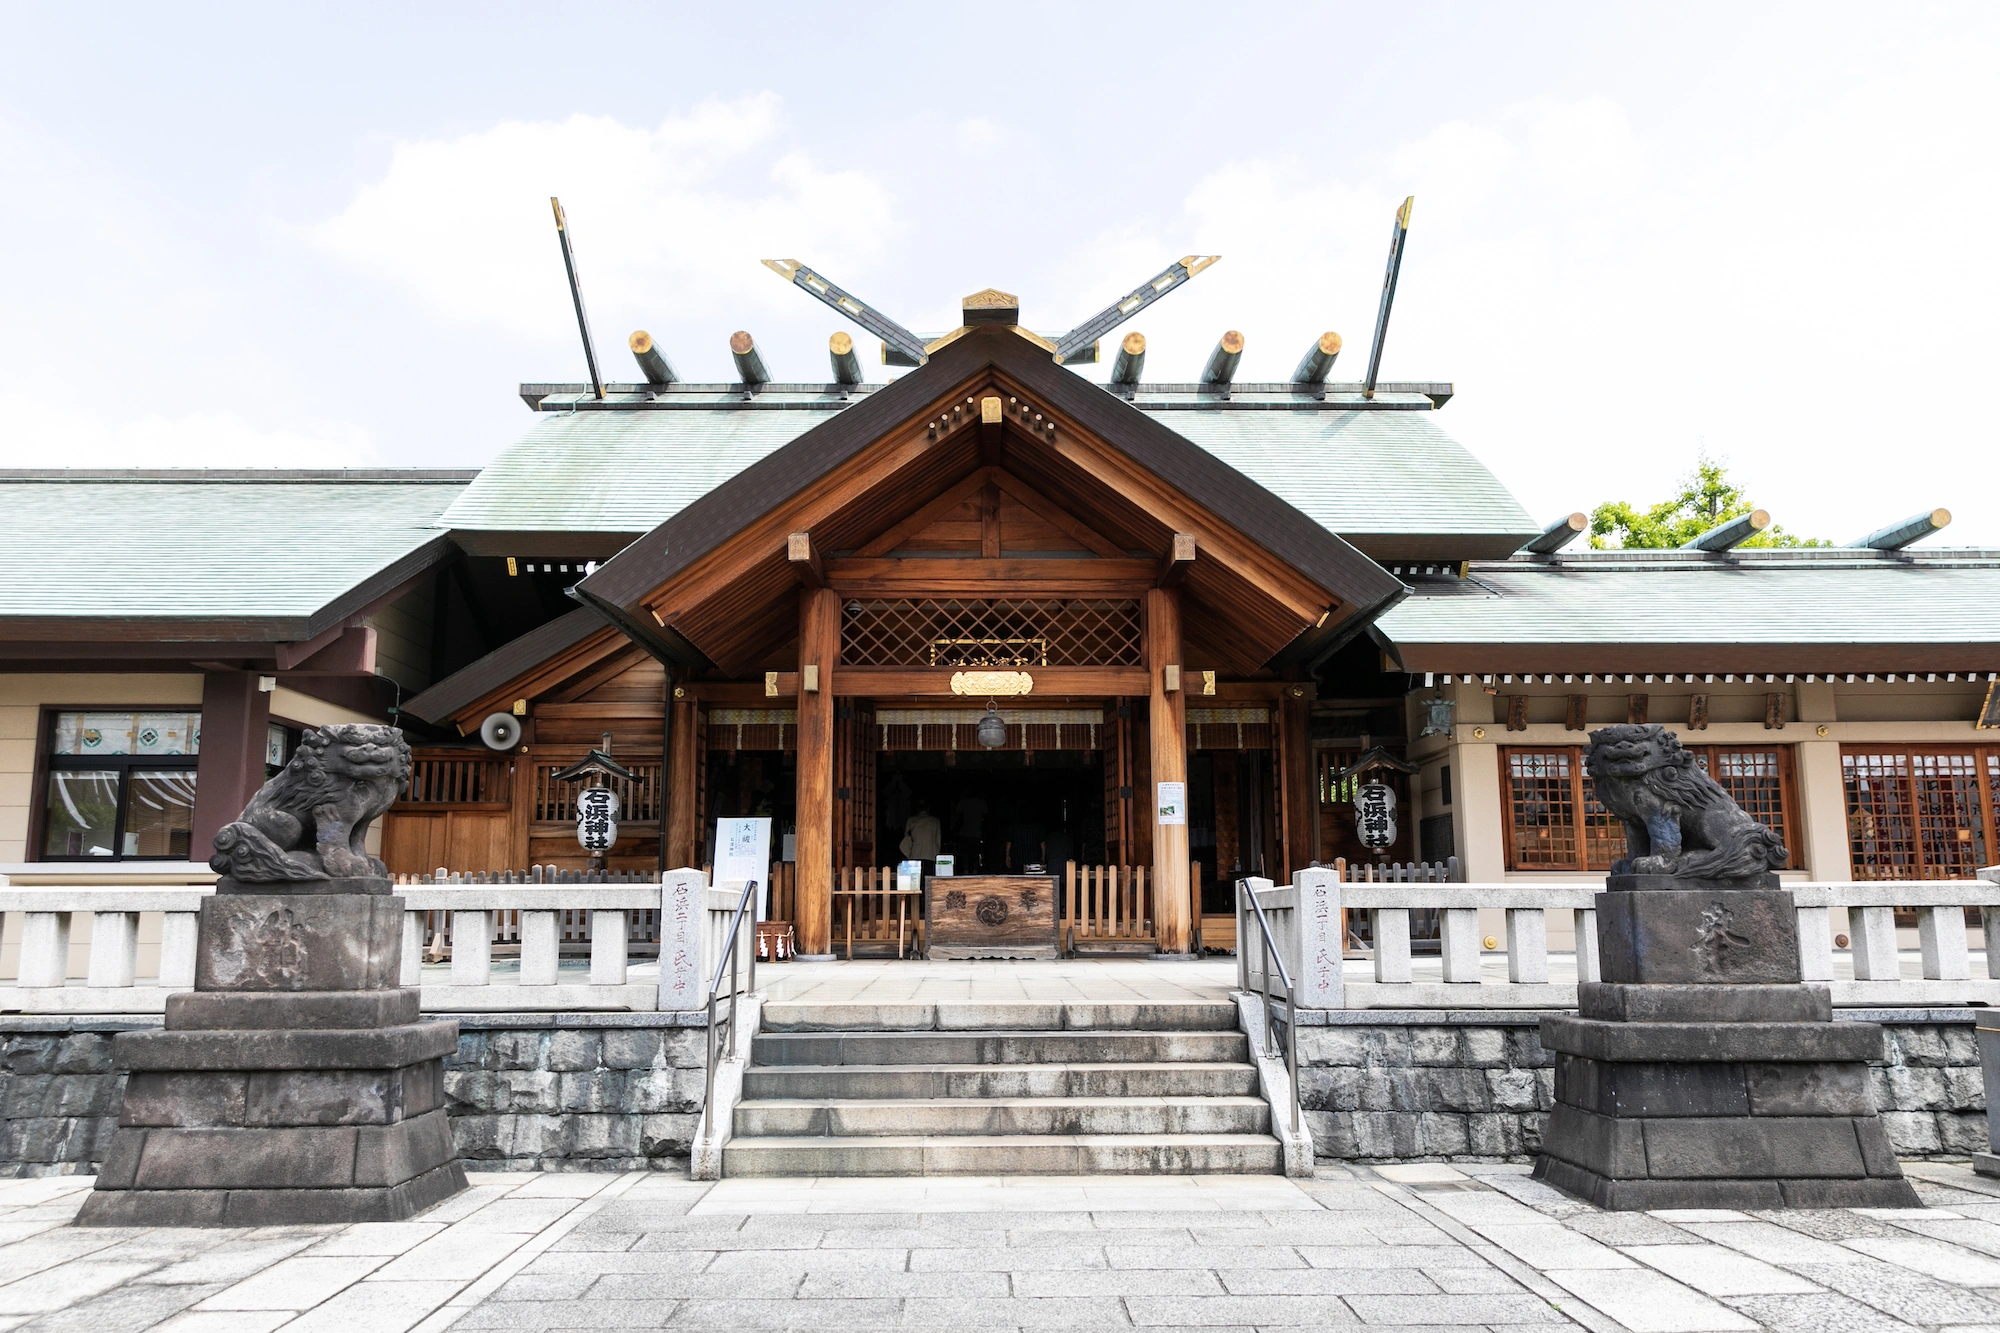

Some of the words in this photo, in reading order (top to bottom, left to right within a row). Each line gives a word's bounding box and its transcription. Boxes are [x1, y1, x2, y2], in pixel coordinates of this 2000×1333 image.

[584, 789, 610, 849] 石浜神社
[1362, 785, 1389, 847] 石浜神社
